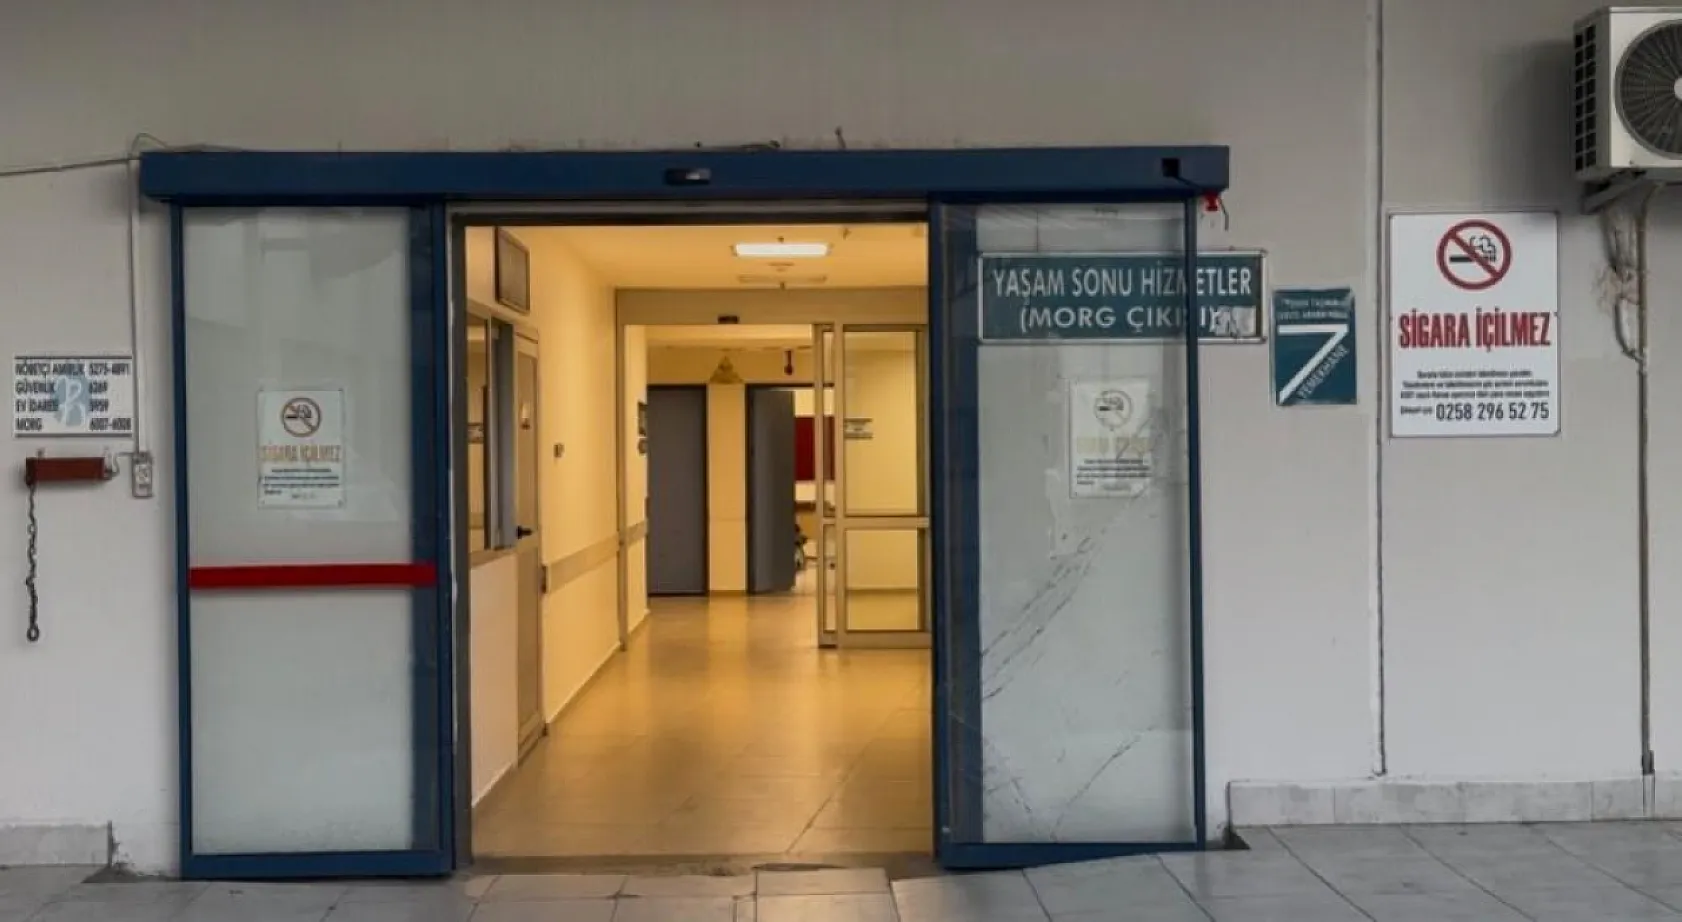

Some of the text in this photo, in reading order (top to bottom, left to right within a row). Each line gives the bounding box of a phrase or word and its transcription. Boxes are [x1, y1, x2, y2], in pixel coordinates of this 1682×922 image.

[993, 266, 1066, 303] YAŞAM
[1071, 266, 1132, 297] SONU
[1021, 305, 1217, 333] (MORG ÇIKII)
[1400, 306, 1551, 352] SİGARA İÇİLMEZ
[15, 379, 55, 393] GÜVENLİK
[15, 399, 27, 411] EV
[1435, 402, 1472, 421] 0258
[1477, 402, 1504, 421] 296
[1508, 402, 1527, 420] 52
[1530, 402, 1550, 420] 75
[15, 417, 43, 430] MORG
